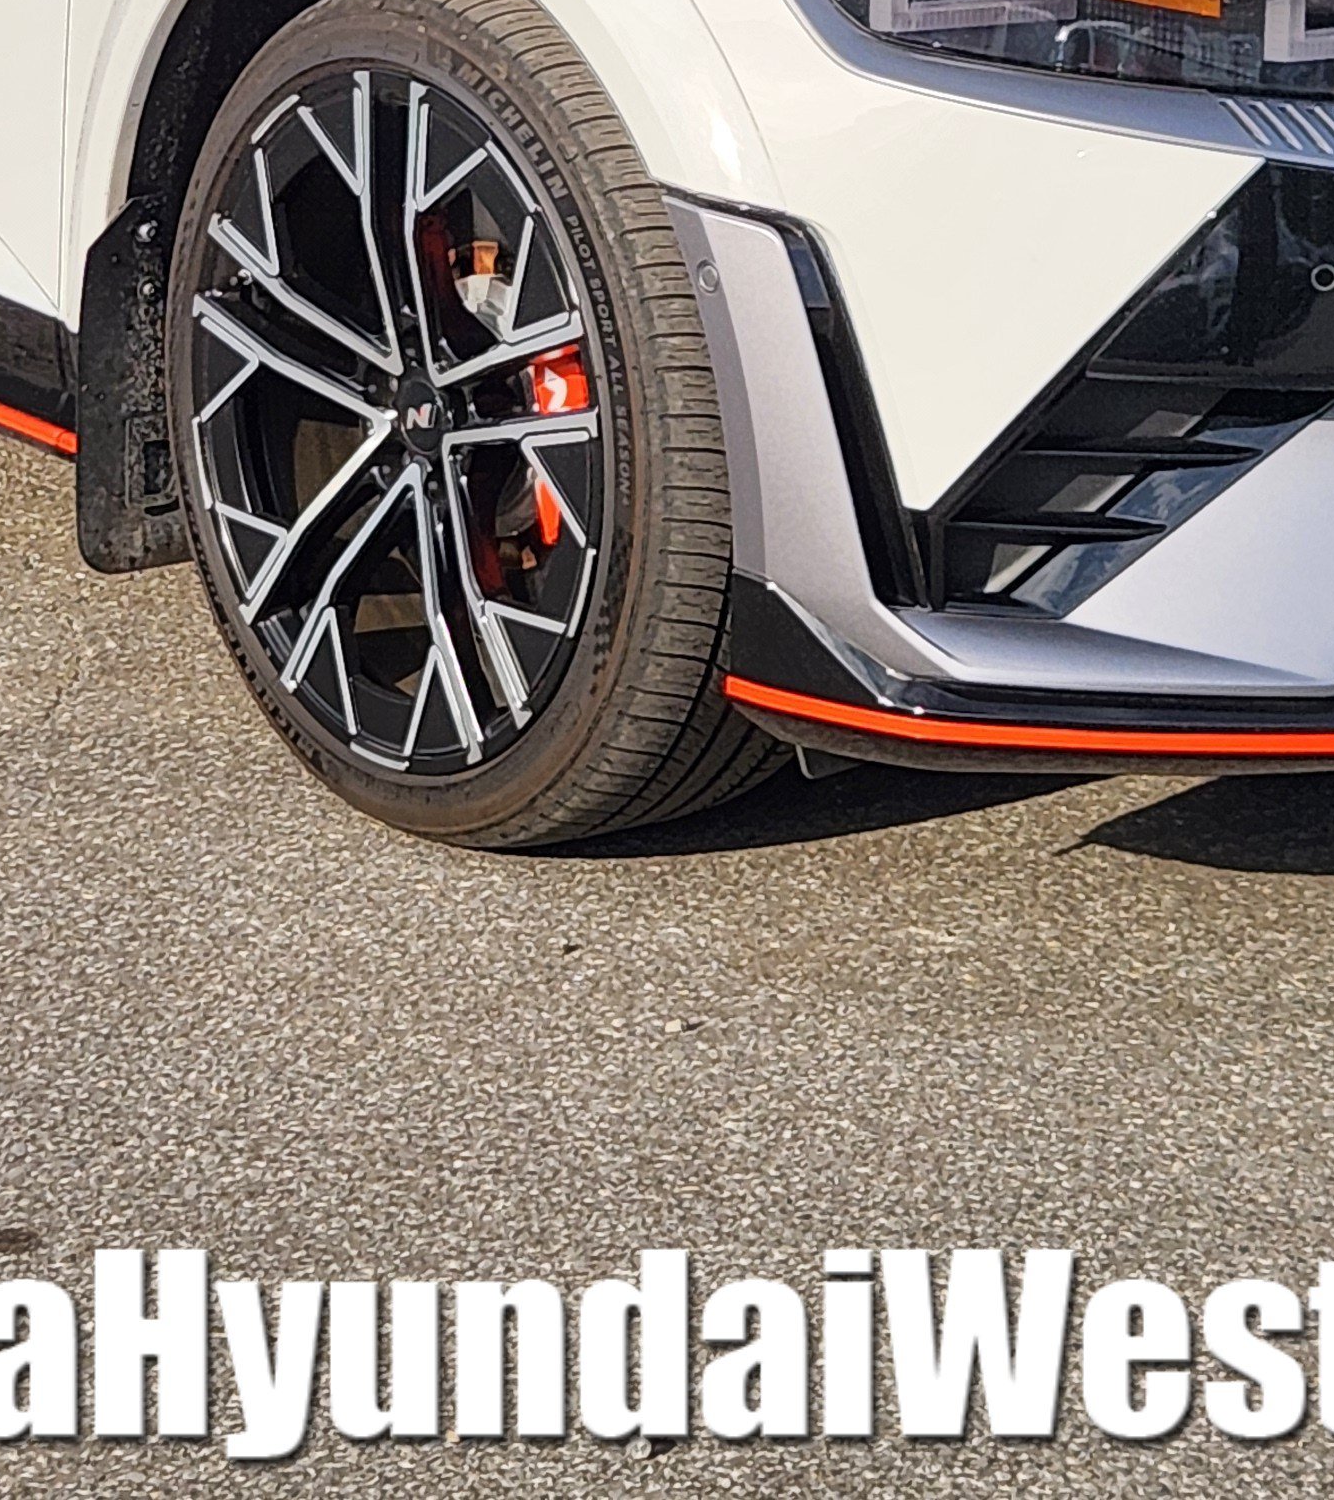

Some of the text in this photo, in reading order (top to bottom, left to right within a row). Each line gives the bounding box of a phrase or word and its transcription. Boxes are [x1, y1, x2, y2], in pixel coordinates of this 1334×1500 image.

[456, 63, 569, 200] MICHELIN
[566, 214, 597, 271] PILOT
[588, 277, 618, 348] SPORT
[607, 354, 624, 396] ALL
[406, 402, 437, 430] N
[614, 404, 632, 494] SEASON
